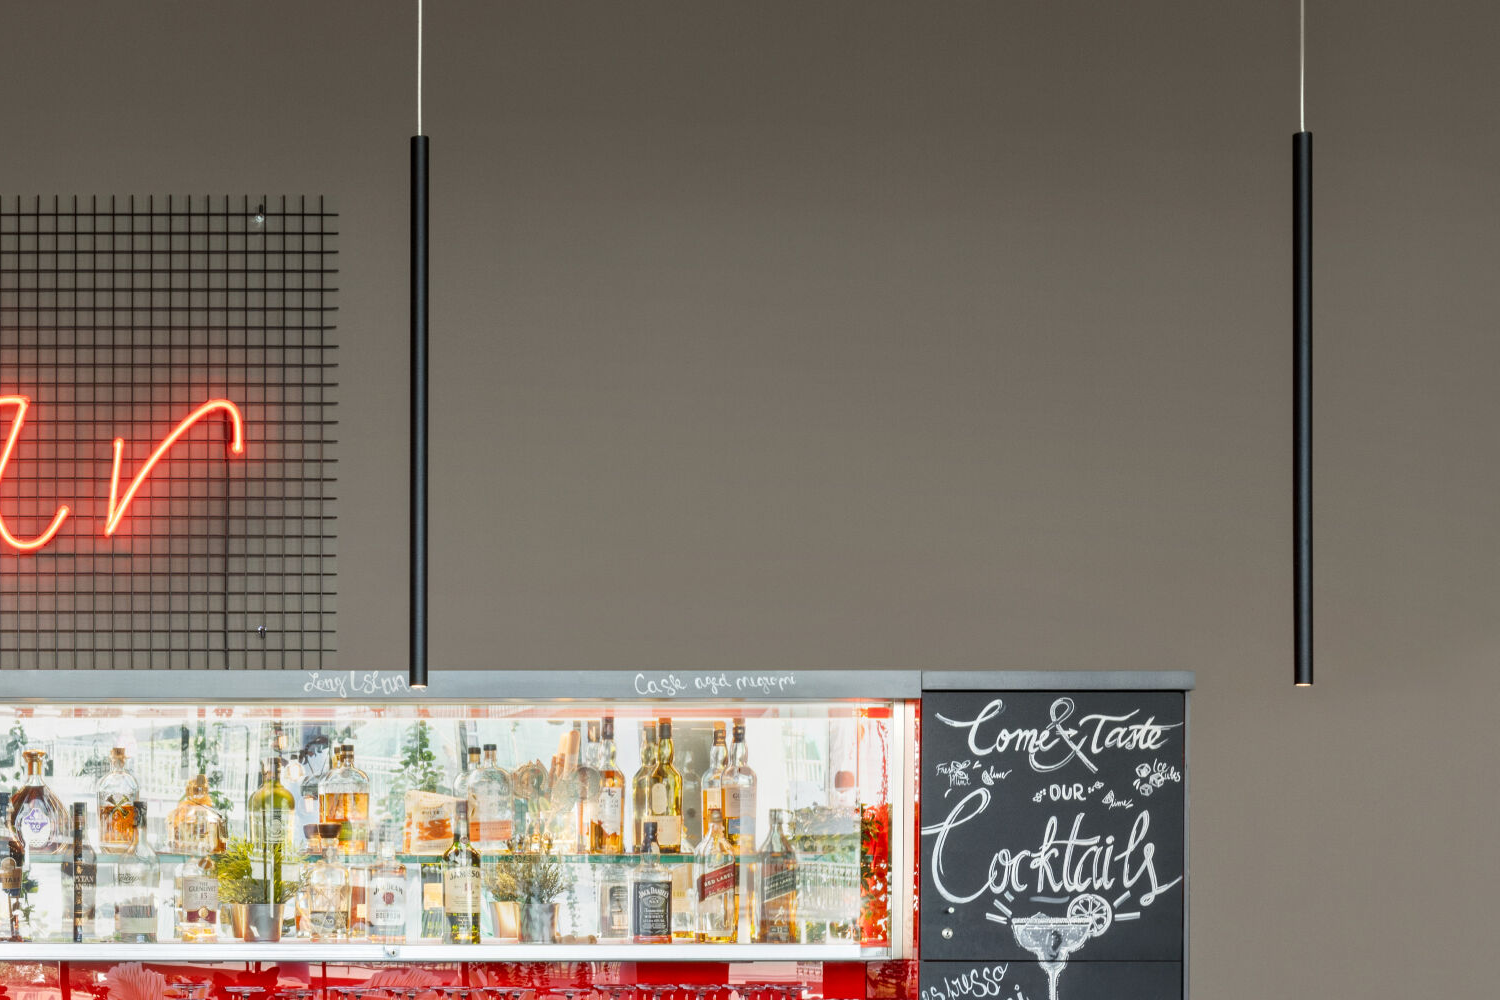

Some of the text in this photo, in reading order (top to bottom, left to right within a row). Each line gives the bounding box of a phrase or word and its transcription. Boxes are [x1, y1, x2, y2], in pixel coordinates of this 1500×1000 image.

[304, 670, 428, 698] Long Islan
[634, 672, 686, 696] Cask
[695, 674, 731, 695] aged
[935, 698, 1062, 756] Come
[1079, 709, 1184, 754] Taste
[1049, 783, 1086, 801] OUR
[921, 788, 1183, 907] Cocktails
